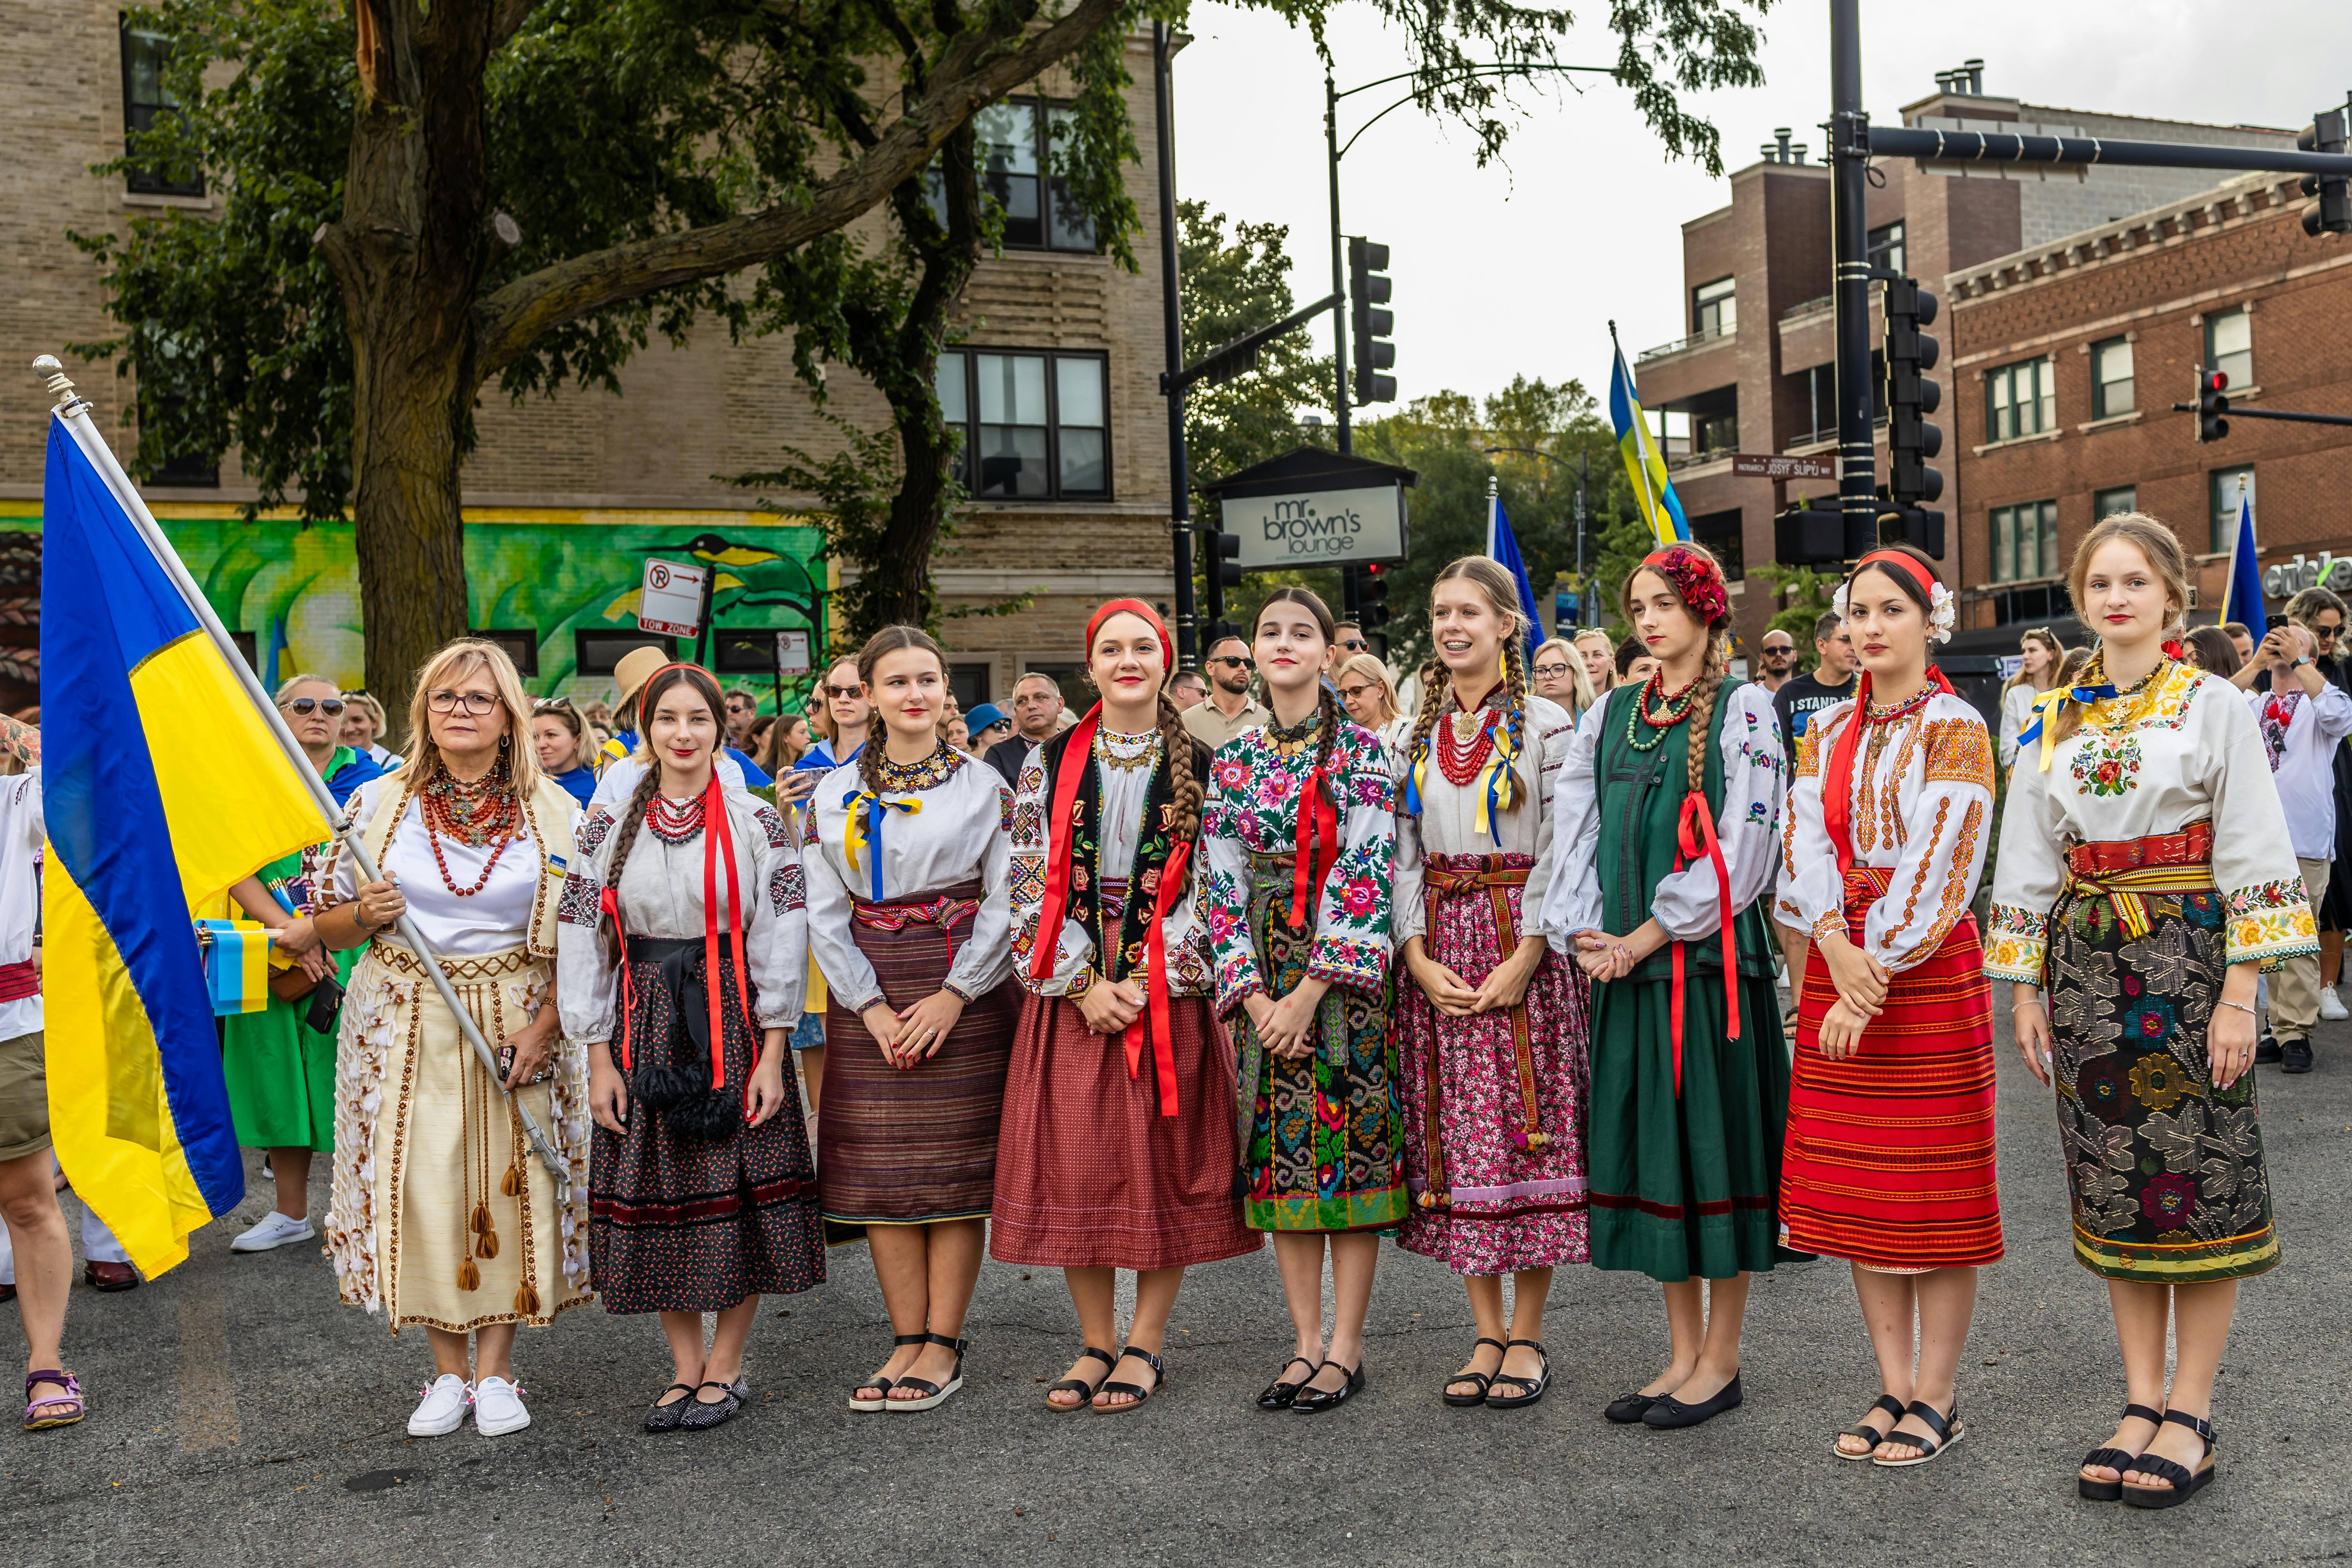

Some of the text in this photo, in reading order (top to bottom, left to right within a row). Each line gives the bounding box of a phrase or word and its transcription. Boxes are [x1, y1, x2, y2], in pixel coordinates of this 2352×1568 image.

[1738, 464, 1764, 472] PATRIARCH
[1767, 464, 1791, 475] JOSYF
[1275, 499, 1316, 520] mr.
[1264, 508, 1361, 540] brown's
[1288, 536, 1354, 555] lounge
[643, 619, 692, 636] TOW ZONE
[1790, 701, 1794, 713] I
